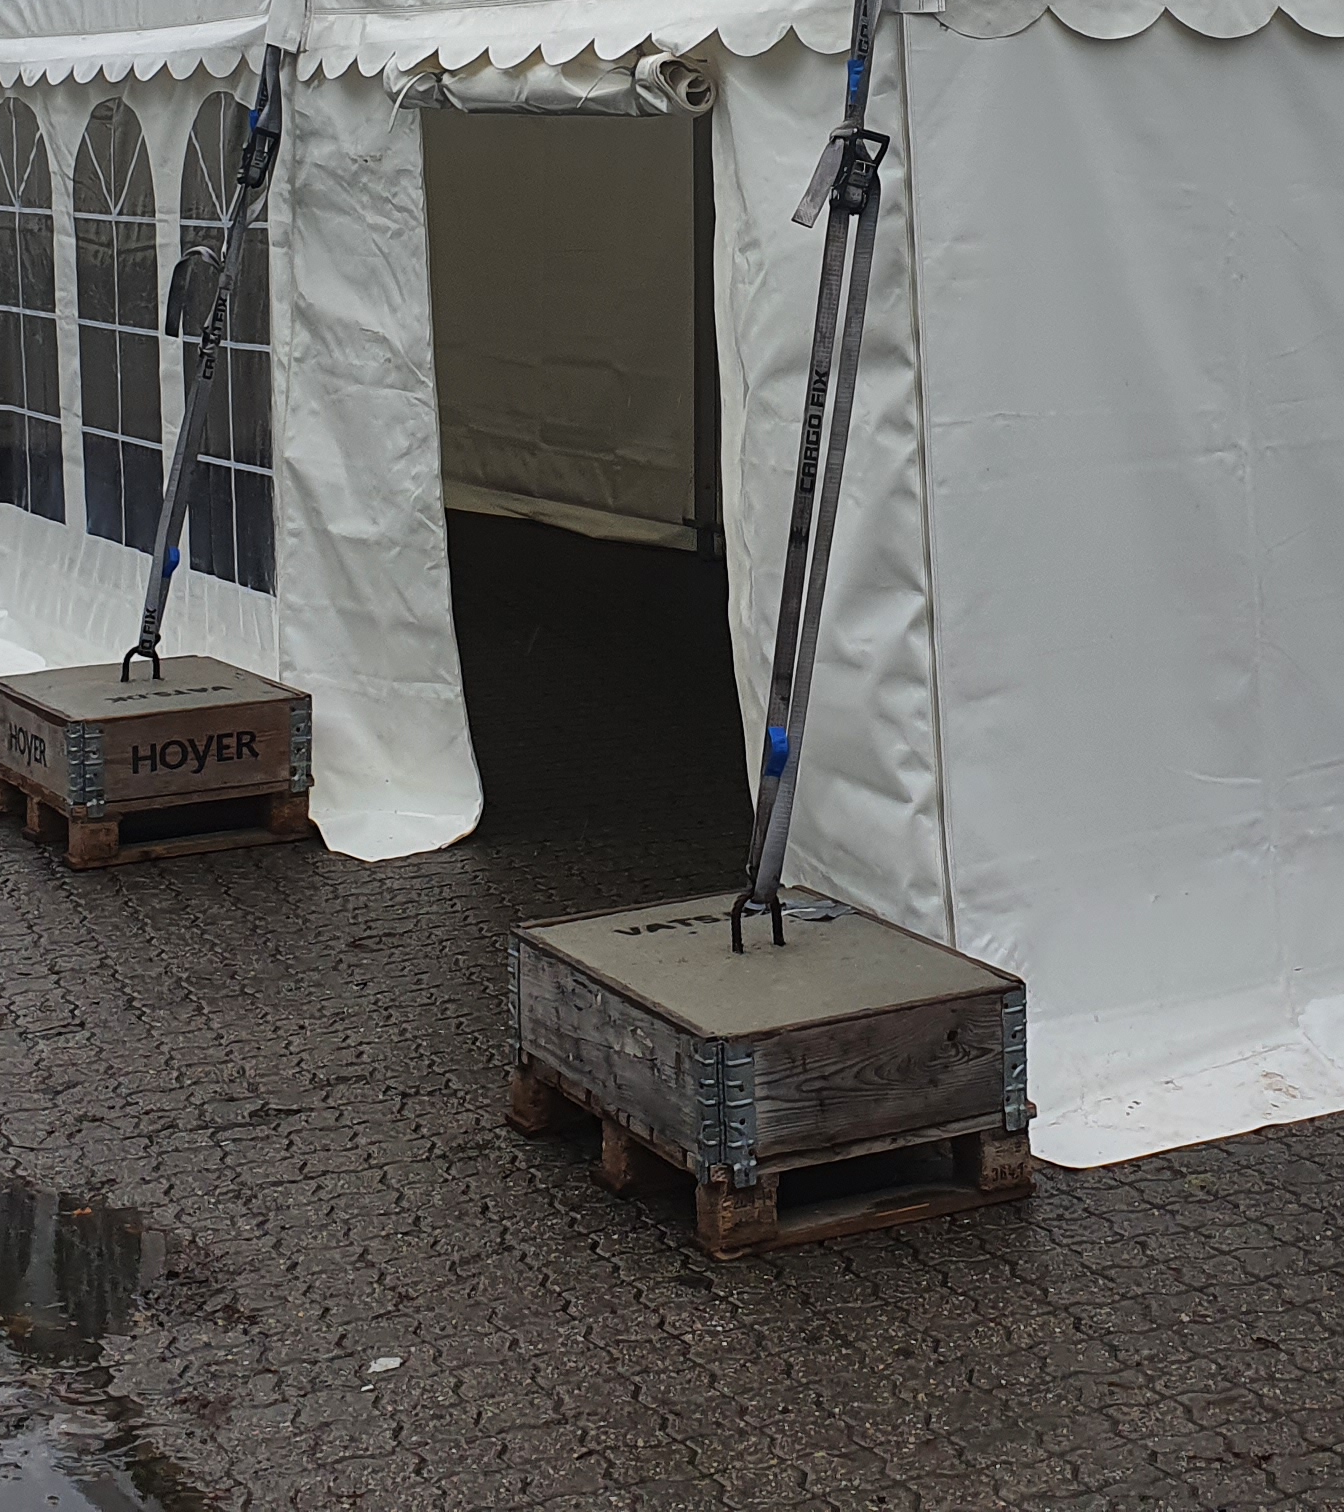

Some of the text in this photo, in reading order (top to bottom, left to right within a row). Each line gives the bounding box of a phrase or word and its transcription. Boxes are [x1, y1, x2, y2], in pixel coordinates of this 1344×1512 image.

[799, 368, 829, 494] CARGO FIX
[8, 721, 48, 768] HOYER
[132, 731, 260, 775] HOYER
